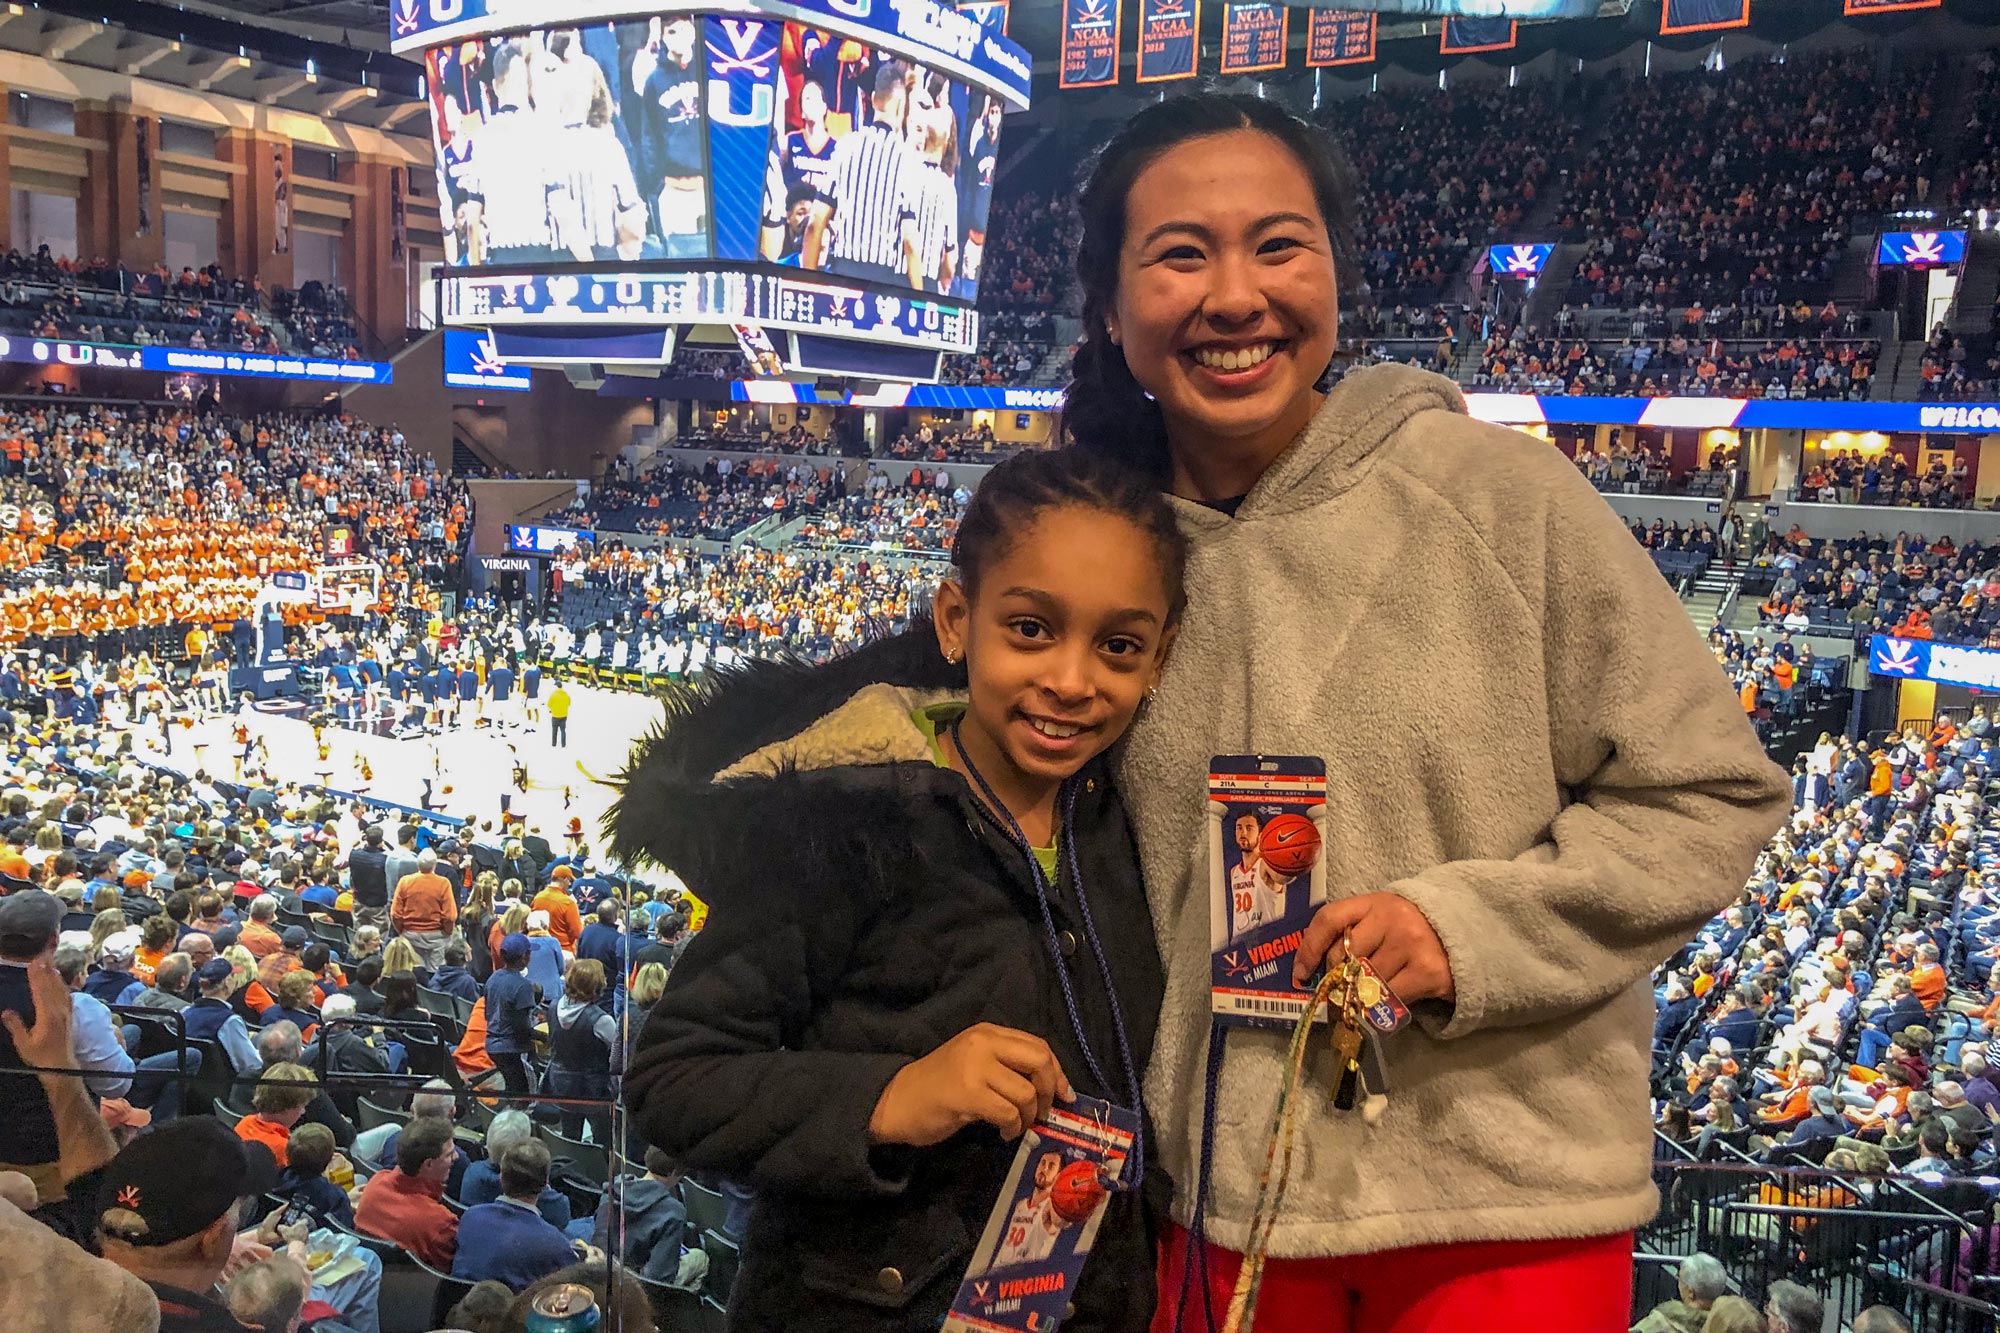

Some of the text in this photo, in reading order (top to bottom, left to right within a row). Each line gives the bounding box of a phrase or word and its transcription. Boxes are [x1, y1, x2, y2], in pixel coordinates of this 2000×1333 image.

[1236, 8, 1274, 24] NCAA
[1151, 18, 1187, 33] NCAA
[1229, 18, 1281, 31] TOURNAMENT
[1316, 25, 1338, 36] 1976
[1074, 27, 1107, 40] NCAA
[1144, 28, 1193, 41] TOURNAMENT
[1230, 29, 1279, 43] 1997 2001
[1228, 40, 1280, 54] 2007 2012
[1315, 36, 1337, 47] 1987
[1093, 48, 1112, 58] 1993
[1228, 51, 1280, 65] 2015 2017
[1314, 48, 1335, 59] 1991
[1921, 406, 2000, 428] WELCO
[481, 558, 531, 570] VIRGINIA
[1235, 892, 1253, 912] 30
[1247, 929, 1304, 966] VIRGINI
[1252, 960, 1279, 981] MIAMI
[998, 1271, 1066, 1300] VIRGINIA
[994, 1297, 1021, 1315] MIAMI
